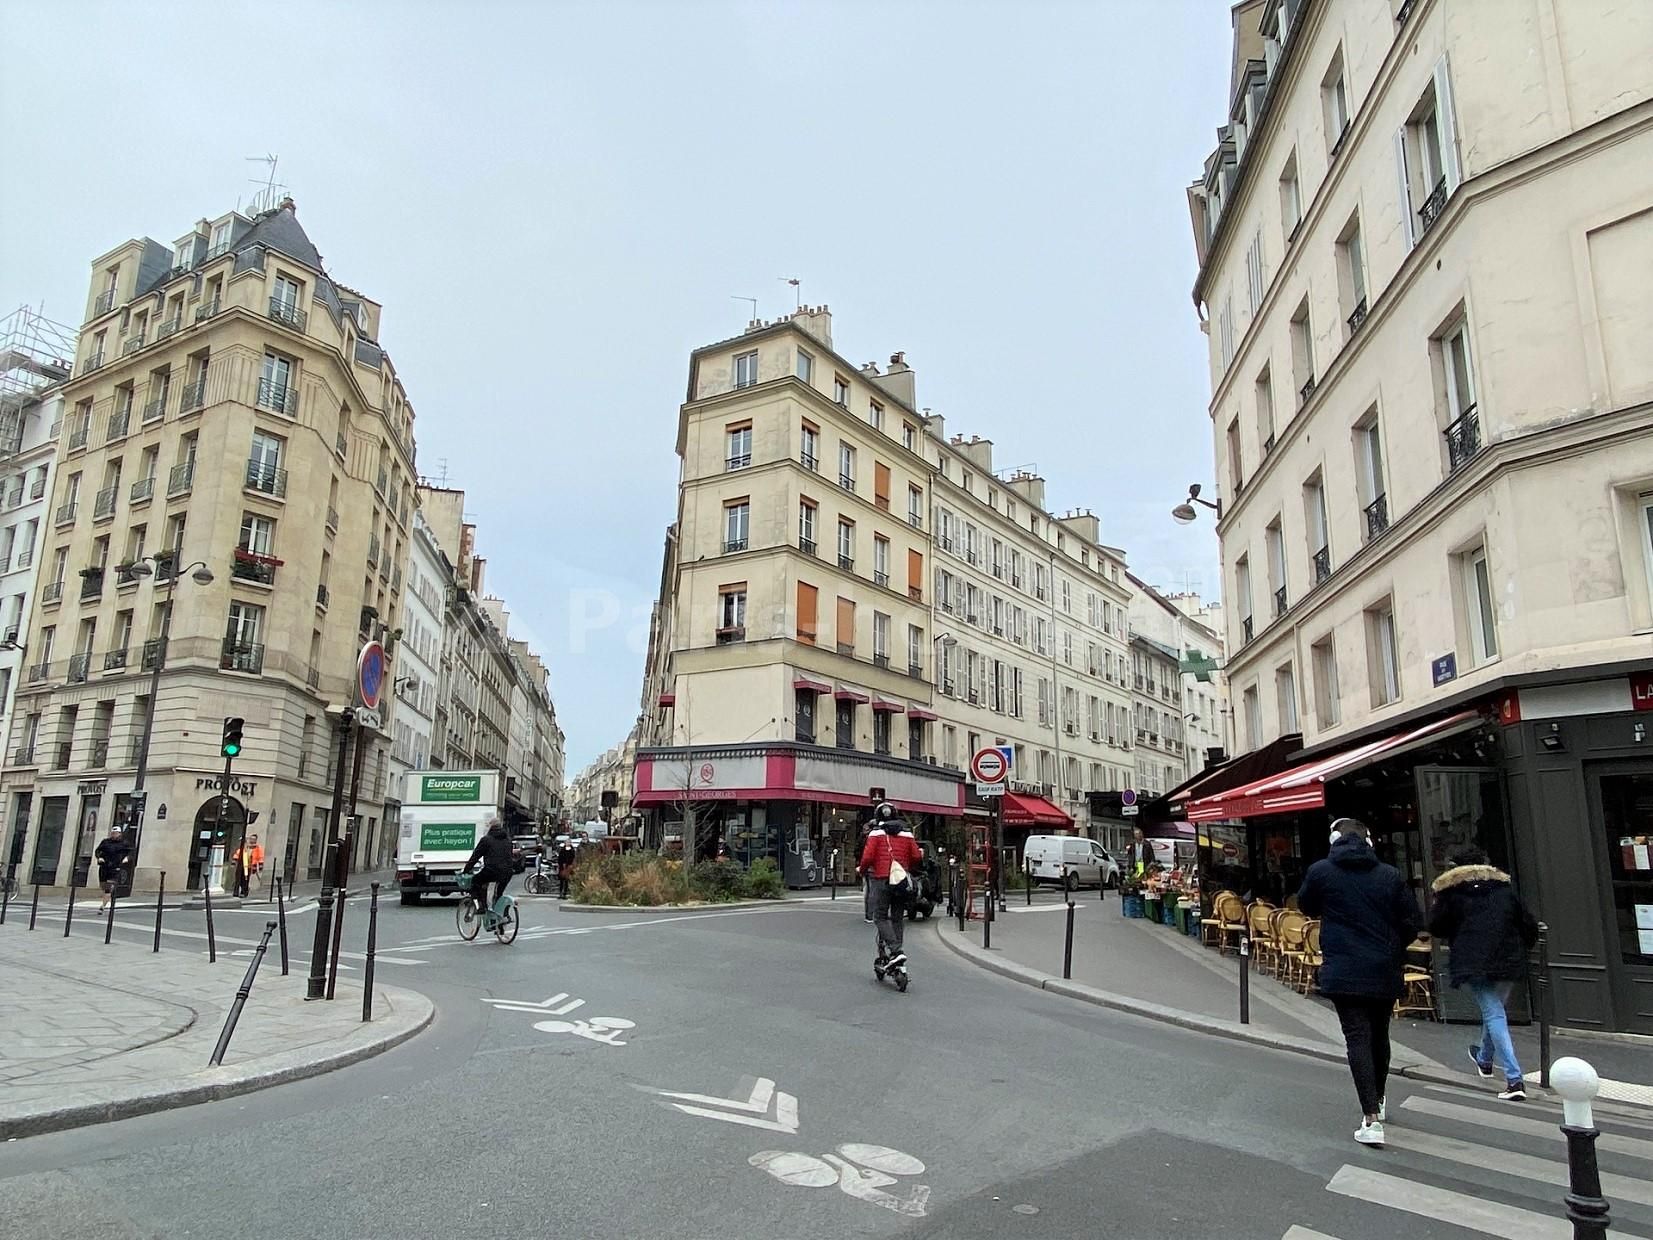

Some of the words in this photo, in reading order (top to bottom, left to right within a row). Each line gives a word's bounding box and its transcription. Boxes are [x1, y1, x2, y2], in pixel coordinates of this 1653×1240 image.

[196, 778, 257, 794] PROOST
[427, 778, 476, 790] Europcar
[679, 790, 737, 799] SANT-GEORGES
[424, 828, 440, 836] Plus
[442, 829, 473, 837] pratique
[443, 838, 468, 846] hayon
